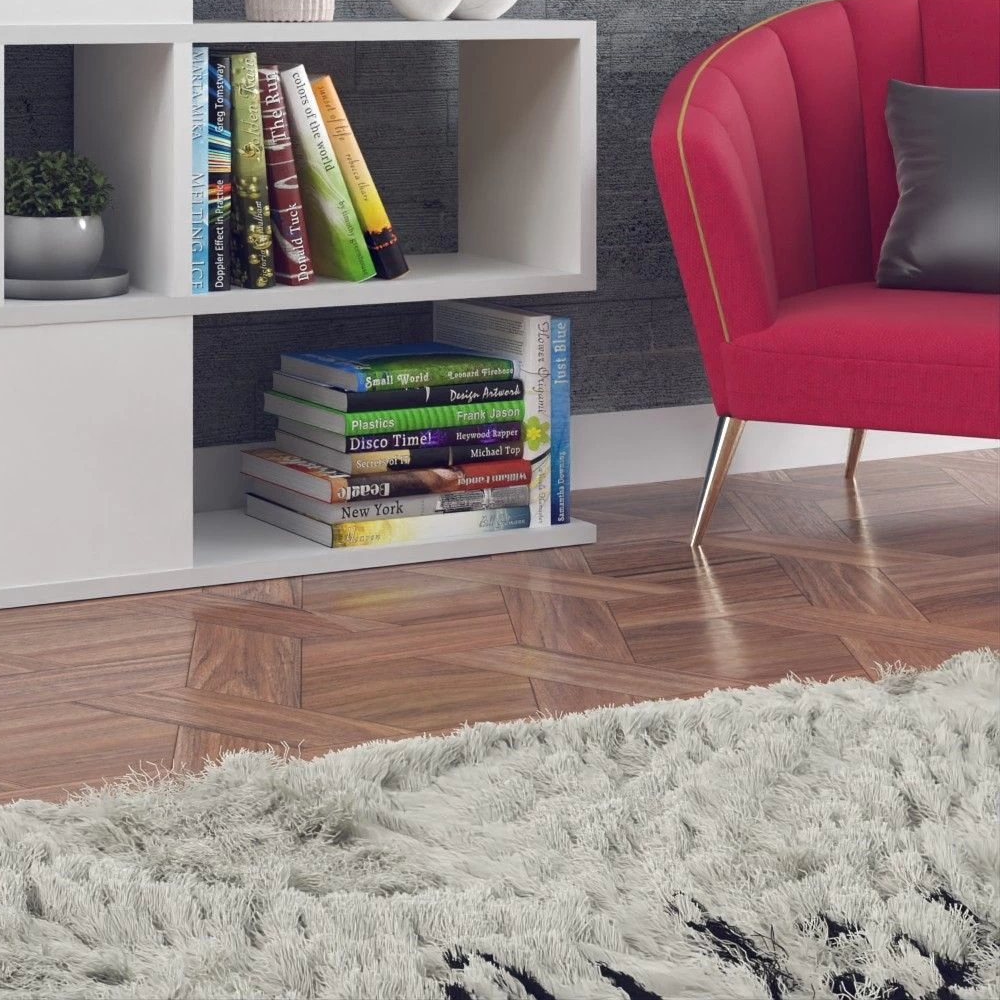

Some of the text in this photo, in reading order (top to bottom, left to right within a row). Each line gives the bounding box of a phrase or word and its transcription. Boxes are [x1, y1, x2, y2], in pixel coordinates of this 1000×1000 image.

[214, 63, 226, 133] Greg Tomstway
[318, 86, 337, 111] sunset
[271, 110, 288, 143] The
[292, 72, 335, 172] colors of the world
[215, 216, 224, 225] in
[192, 173, 205, 290] MELTING ICE
[214, 226, 225, 257] Effect
[288, 202, 311, 282] Donald Tuck
[214, 261, 226, 288] Doppler
[552, 322, 569, 385] Just Blue
[365, 372, 430, 389] Small World
[449, 388, 481, 403] Design
[457, 407, 521, 422] Frank Jason
[351, 417, 396, 432] Plastics
[349, 432, 433, 451] Disco Time!
[456, 429, 519, 442] Heywood Rapper
[470, 445, 521, 459] Michael Top
[336, 482, 391, 500] Beagle
[341, 501, 404, 520] New York
